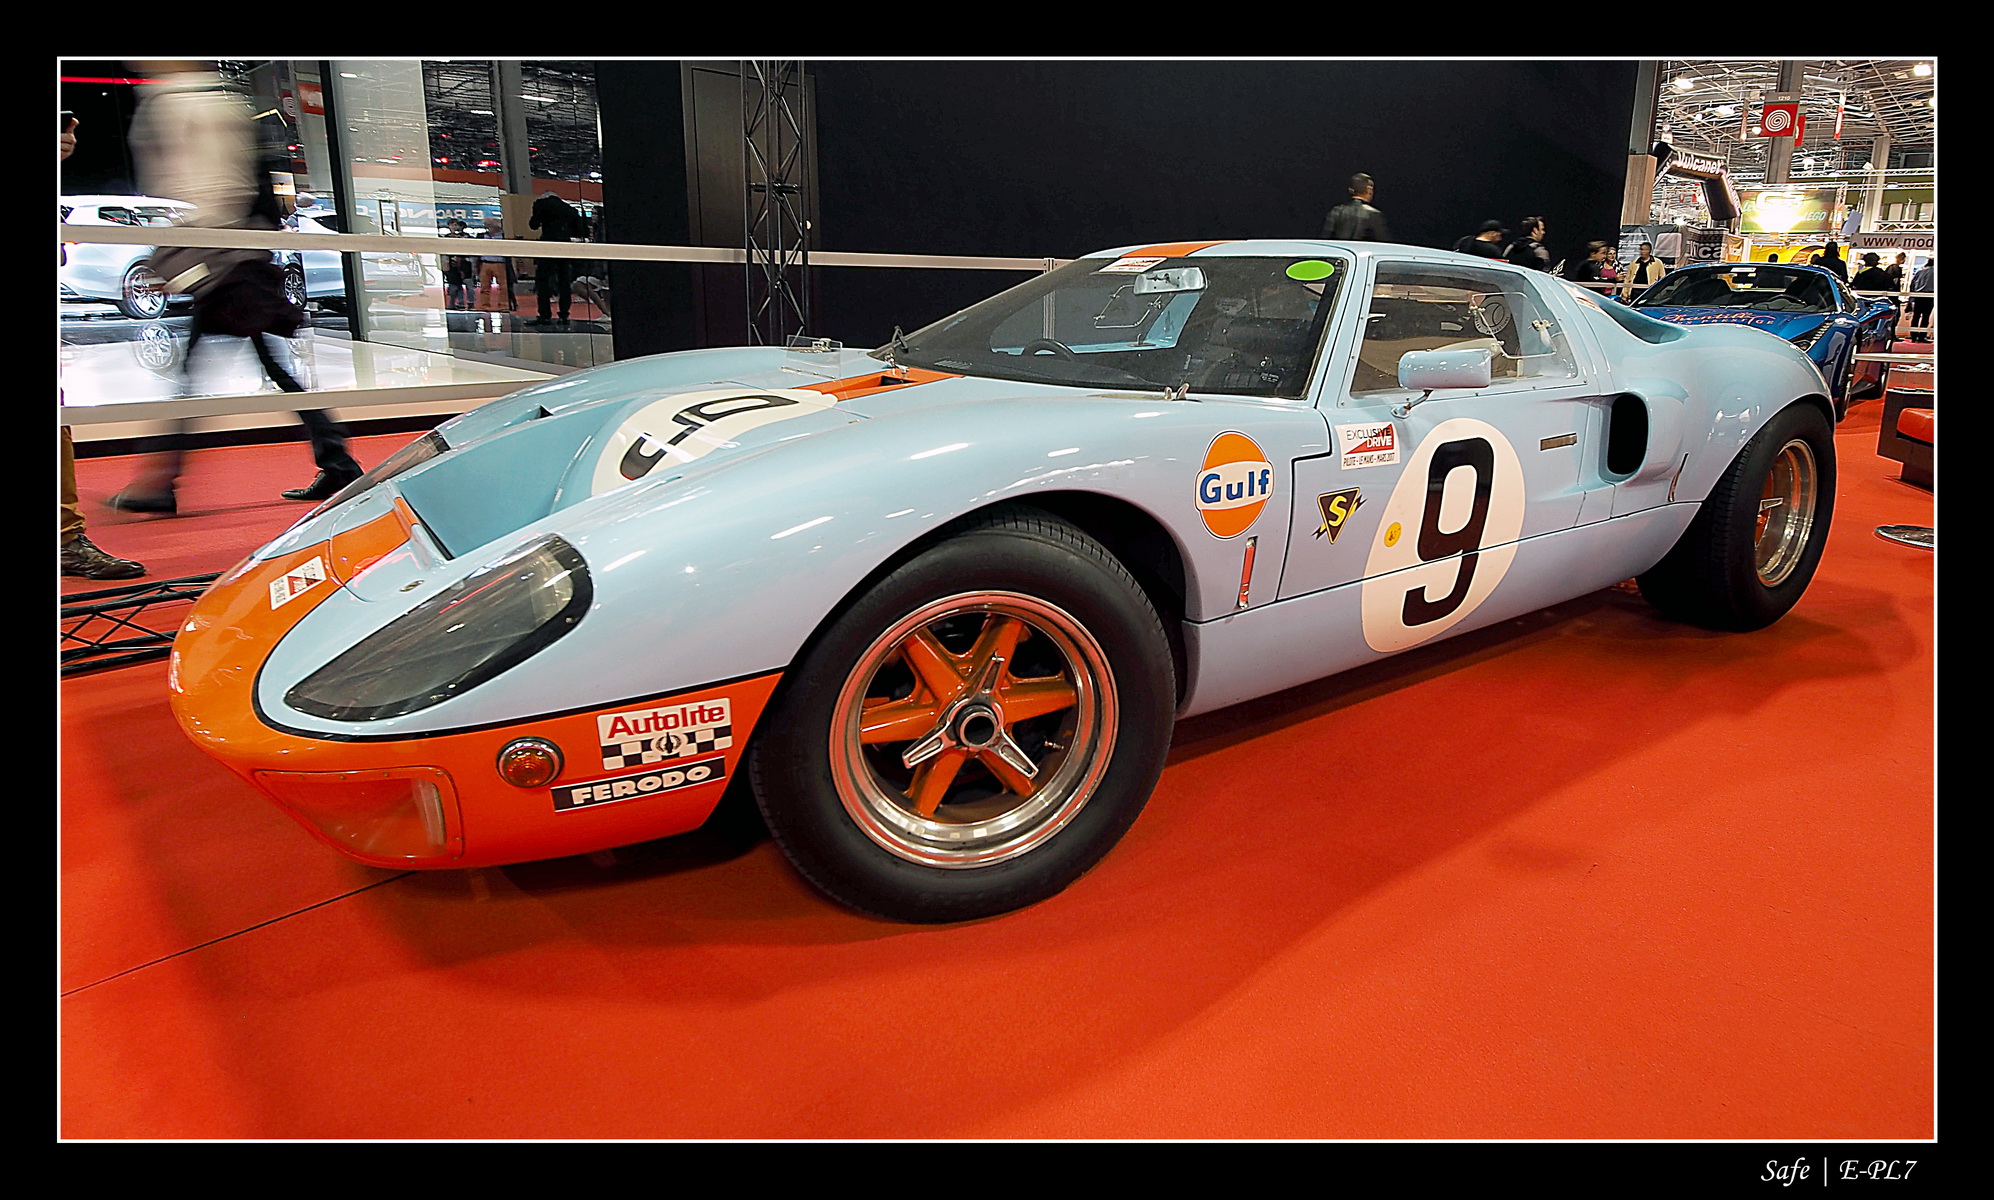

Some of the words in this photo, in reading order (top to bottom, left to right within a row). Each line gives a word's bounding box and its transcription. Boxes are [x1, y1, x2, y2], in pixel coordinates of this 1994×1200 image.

[1677, 151, 1721, 175] Vulcanet
[1346, 427, 1392, 441] EXCLUSIVE
[1366, 436, 1393, 448] DRIVE
[1199, 469, 1270, 504] Gulf
[1328, 495, 1348, 527] S
[1402, 437, 1494, 626] 9
[608, 705, 725, 738] Autolite
[571, 765, 712, 805] FERODO
